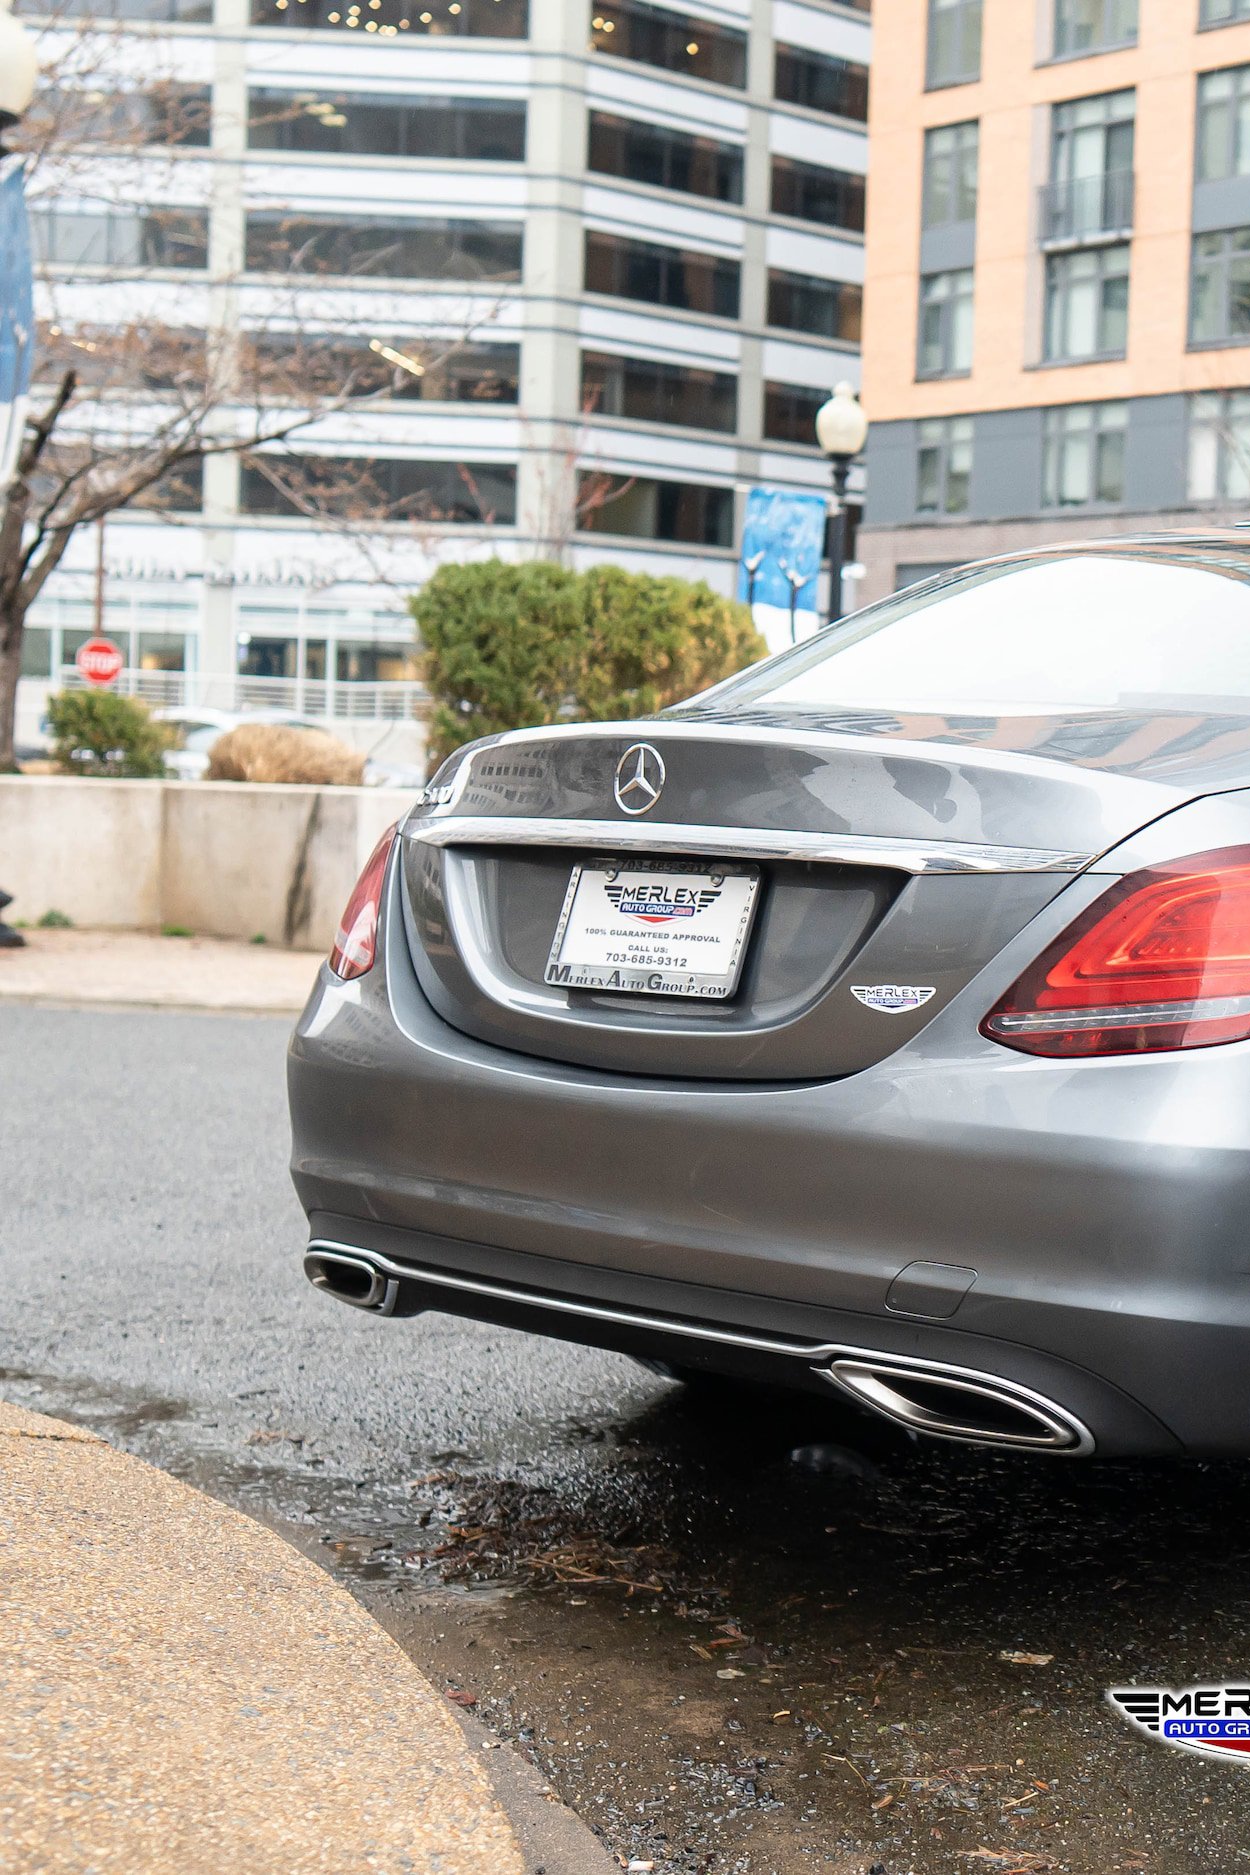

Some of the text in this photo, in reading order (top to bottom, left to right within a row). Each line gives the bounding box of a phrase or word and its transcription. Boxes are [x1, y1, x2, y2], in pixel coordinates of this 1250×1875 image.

[79, 651, 121, 674] STOP
[622, 885, 699, 904] MERLEX
[621, 903, 645, 912] AUTO
[729, 885, 755, 967] VIRGINIA
[585, 928, 721, 943] 100% GUARANTEED APPROVAL
[606, 952, 688, 967] 703-685-9312
[866, 988, 918, 997] MERLEX
